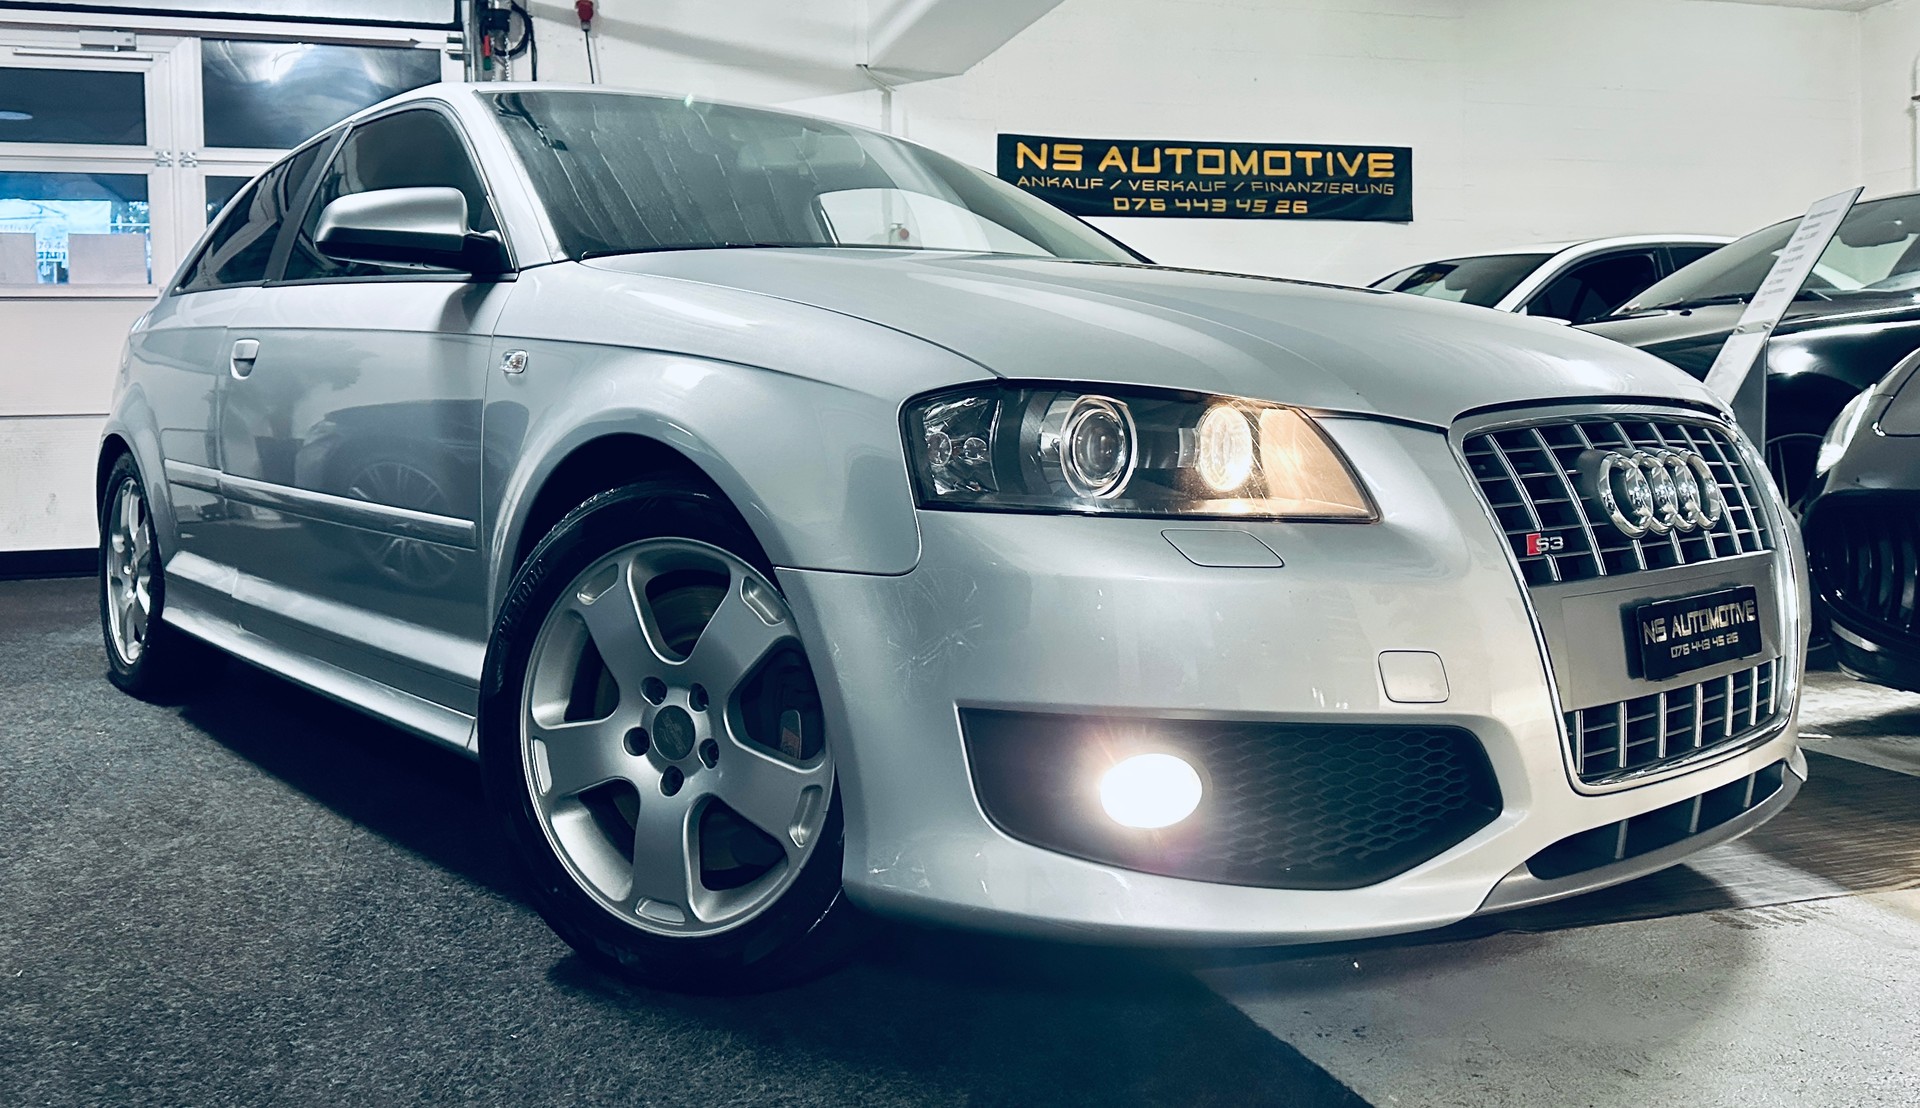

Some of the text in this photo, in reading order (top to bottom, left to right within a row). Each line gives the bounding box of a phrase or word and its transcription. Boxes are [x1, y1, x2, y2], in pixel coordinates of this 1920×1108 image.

[1016, 142, 1395, 178] NS AUTOMOTIVE
[1017, 176, 1104, 190] ANKAUF
[1128, 179, 1227, 192] VERKAUF
[1251, 181, 1394, 195] FINANZIERUNG
[1113, 197, 1308, 214] 076 443 45 26
[1536, 536, 1564, 552] S3
[1643, 600, 1756, 645] NS AUTOMOTIVE
[1671, 631, 1739, 658] 076 443 45 26
